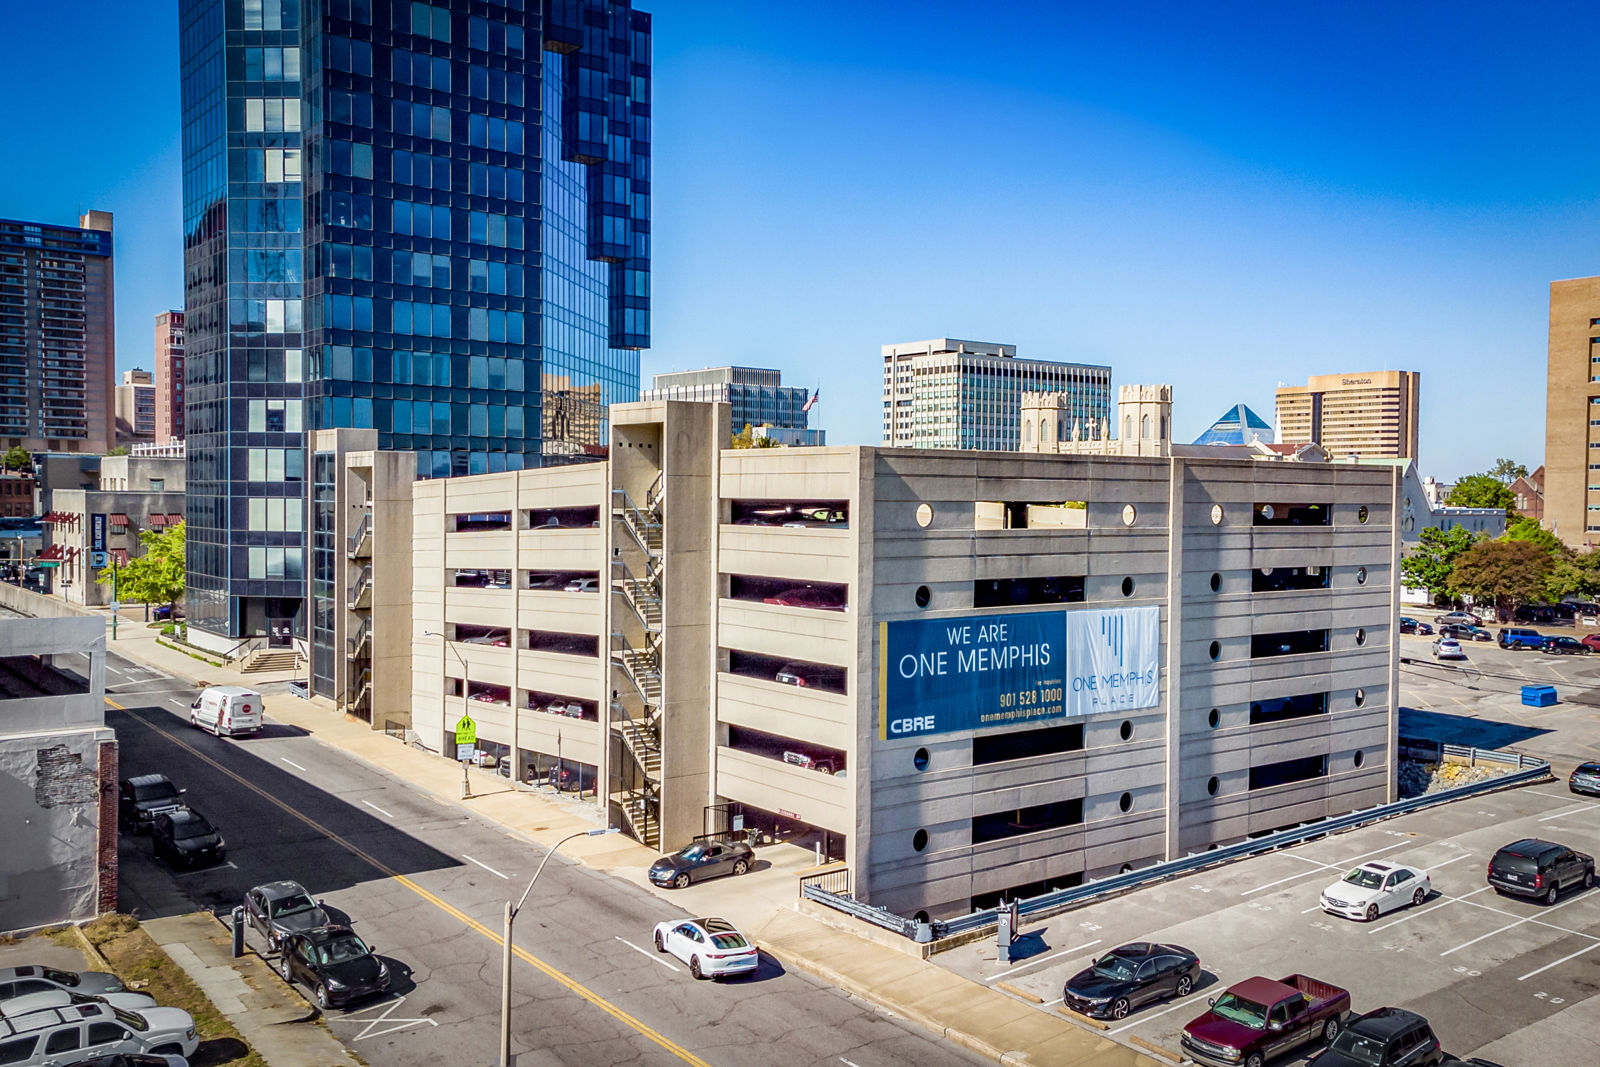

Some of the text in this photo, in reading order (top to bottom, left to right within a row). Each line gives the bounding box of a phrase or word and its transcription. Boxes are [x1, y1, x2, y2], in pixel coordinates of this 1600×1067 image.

[946, 623, 1008, 646] WE ARE
[899, 643, 1051, 679] ONE MEMPHIS
[1072, 675, 1097, 692] ONE
[1102, 670, 1153, 688] MEMPHIS
[1000, 687, 1062, 708] 901 528 1000
[890, 715, 935, 733] CBRE
[980, 705, 1062, 723] onememphisplace.com
